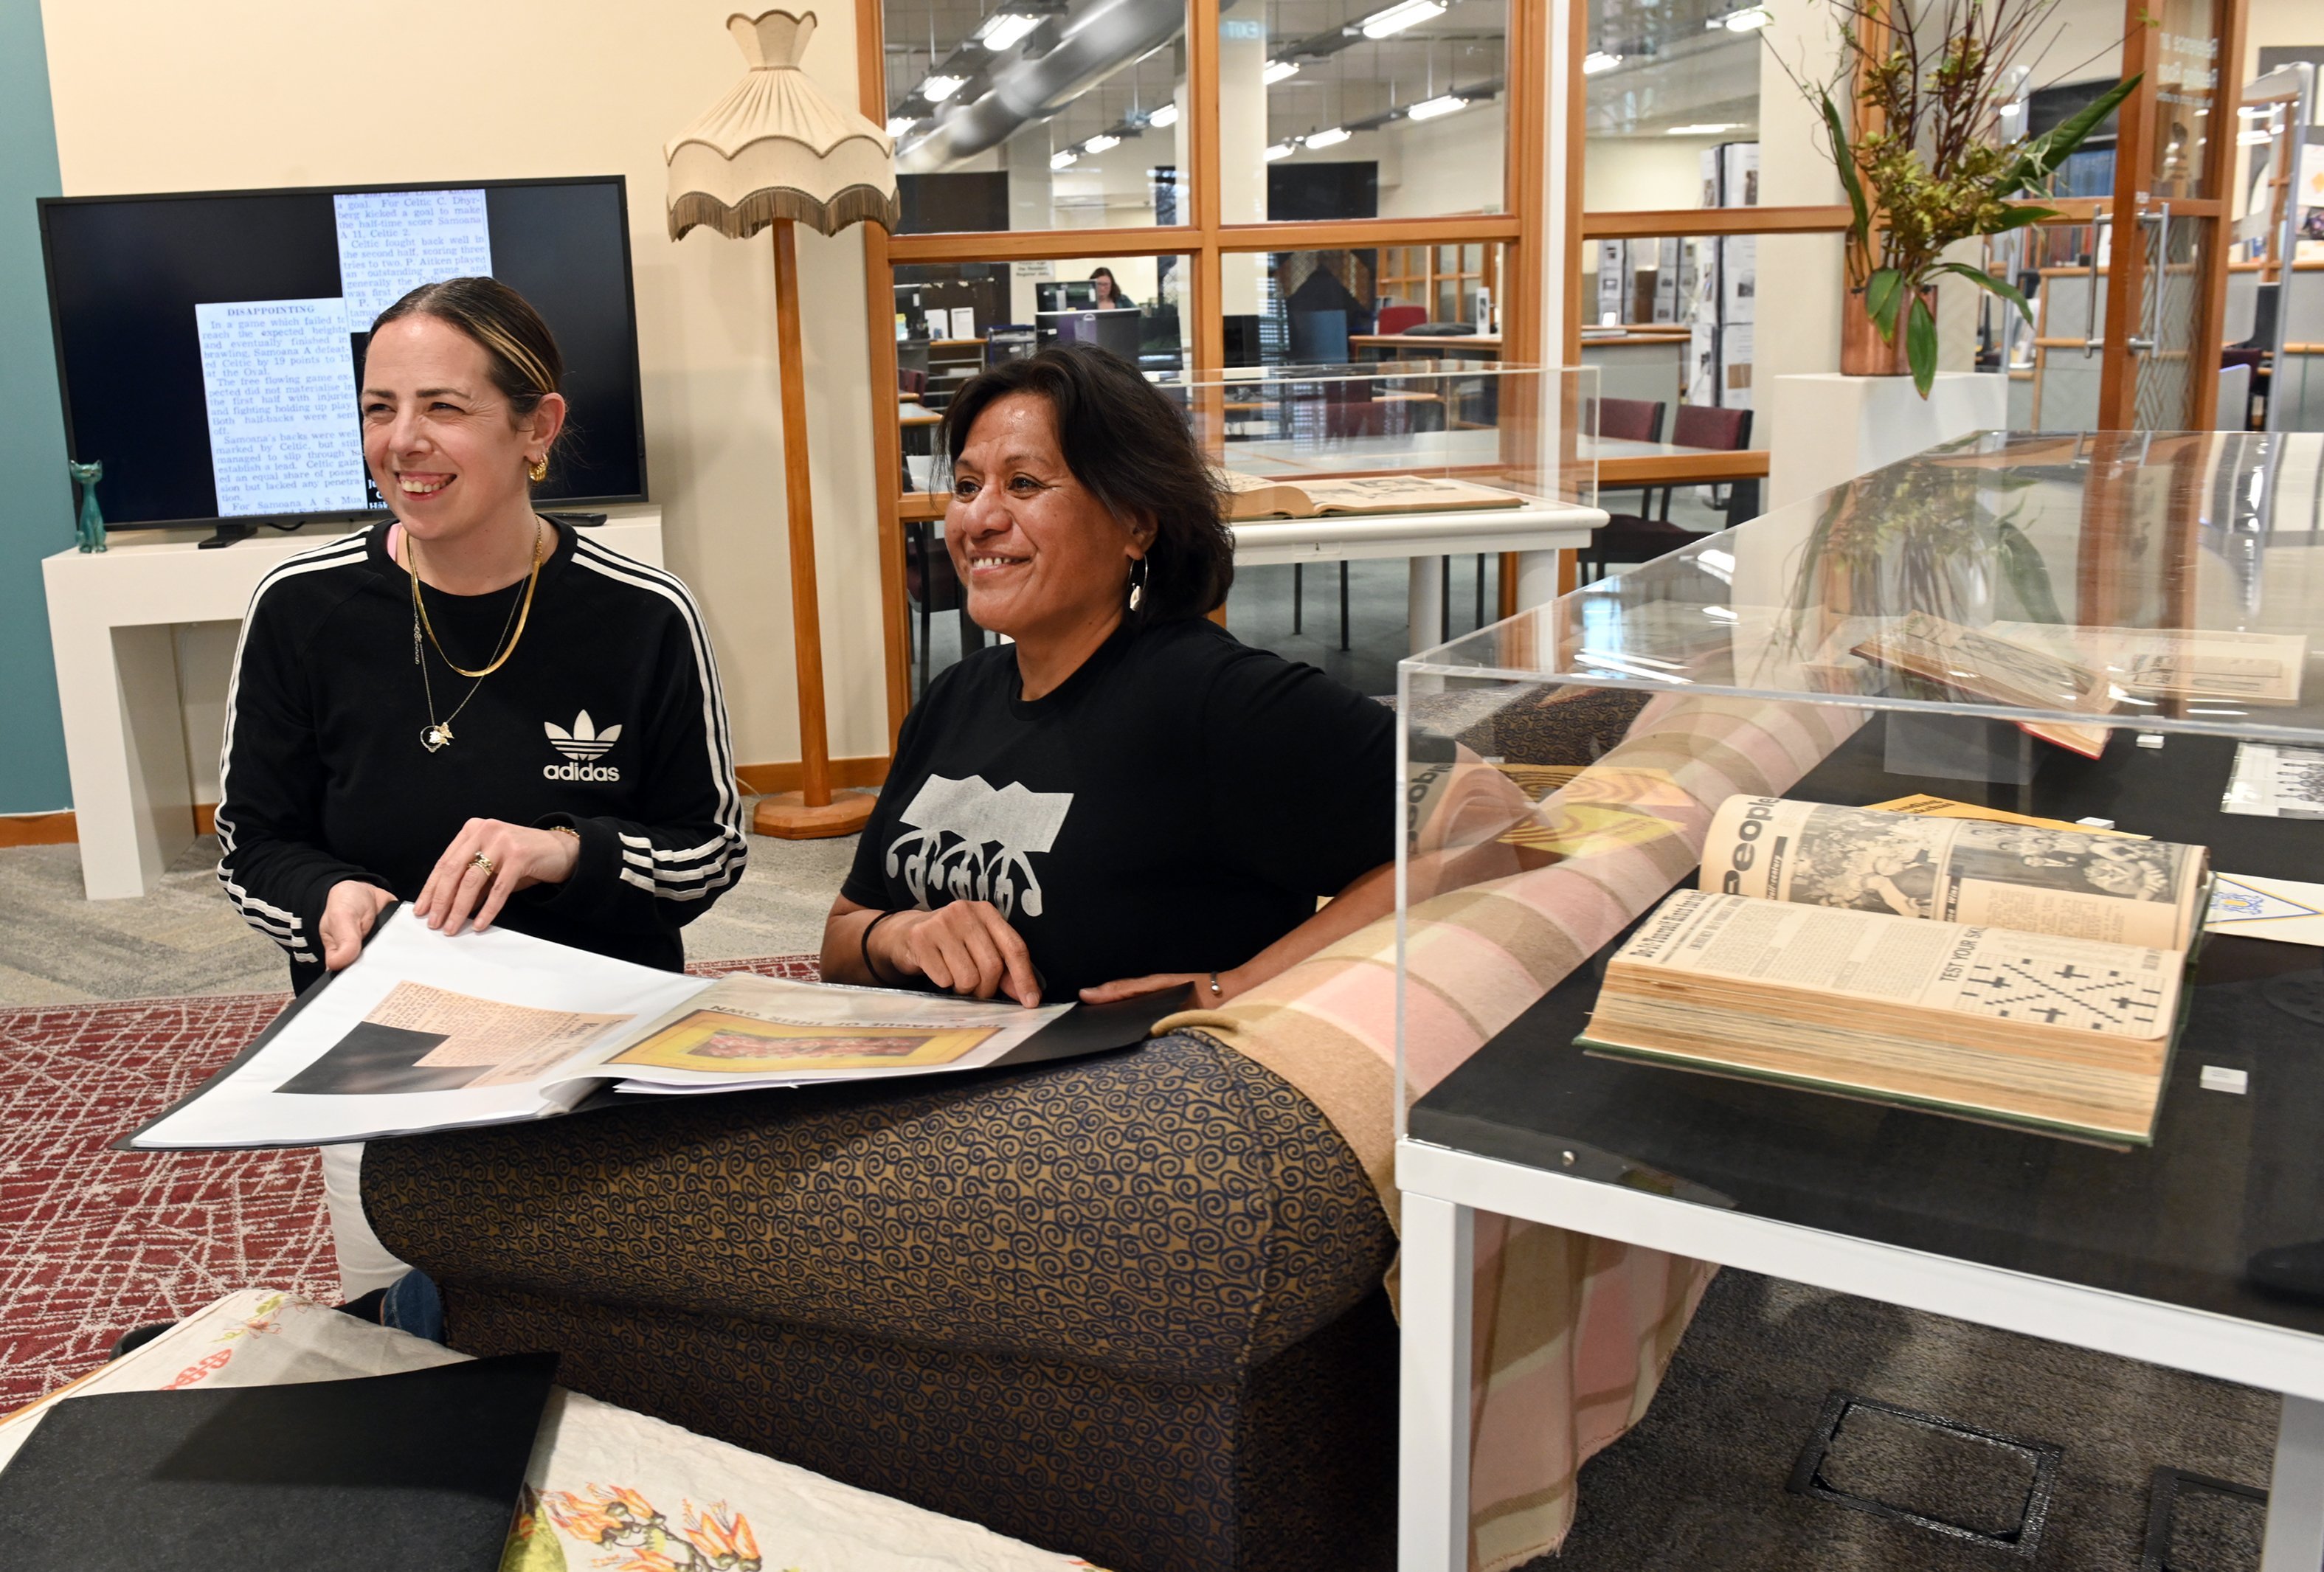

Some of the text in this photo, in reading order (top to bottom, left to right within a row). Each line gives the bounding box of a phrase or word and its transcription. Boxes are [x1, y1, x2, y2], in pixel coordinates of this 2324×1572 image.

[338, 211, 359, 220] berg
[365, 209, 396, 217] kicked
[414, 208, 433, 218] goal
[386, 238, 415, 248] fought
[362, 249, 393, 257] second
[423, 247, 457, 256] scoring
[455, 255, 485, 266] played
[368, 268, 422, 277] outstanding
[434, 268, 459, 276] game
[347, 279, 391, 289] generally
[227, 305, 314, 316] DISAPPOINTING
[238, 321, 265, 329] game
[202, 331, 229, 339] reach
[261, 328, 304, 338] expected
[313, 326, 346, 336] heights
[231, 339, 282, 348] eventually
[292, 336, 329, 345] finished
[257, 358, 268, 367] by
[291, 356, 320, 366] points
[265, 376, 300, 385] flowing
[306, 376, 332, 384] game
[209, 388, 240, 399] pected
[286, 384, 340, 393] materialise
[318, 393, 354, 402] injuries
[234, 406, 270, 416] fighting
[275, 404, 310, 413] holding
[245, 414, 294, 423] half-backs
[216, 445, 253, 454] marked
[261, 445, 272, 454] by
[217, 454, 261, 464] managed
[284, 452, 301, 461] slip
[308, 450, 344, 459] through
[218, 464, 260, 473] establish
[252, 472, 278, 483] equal
[266, 481, 296, 489] lacked
[325, 479, 363, 489] penetra-
[543, 762, 620, 782] adidas
[1723, 798, 1780, 896] People
[1951, 940, 1978, 960] YOUR
[1939, 962, 1965, 981] TEST
[710, 1005, 760, 1017] OWN
[768, 1015, 823, 1026] THEIR
